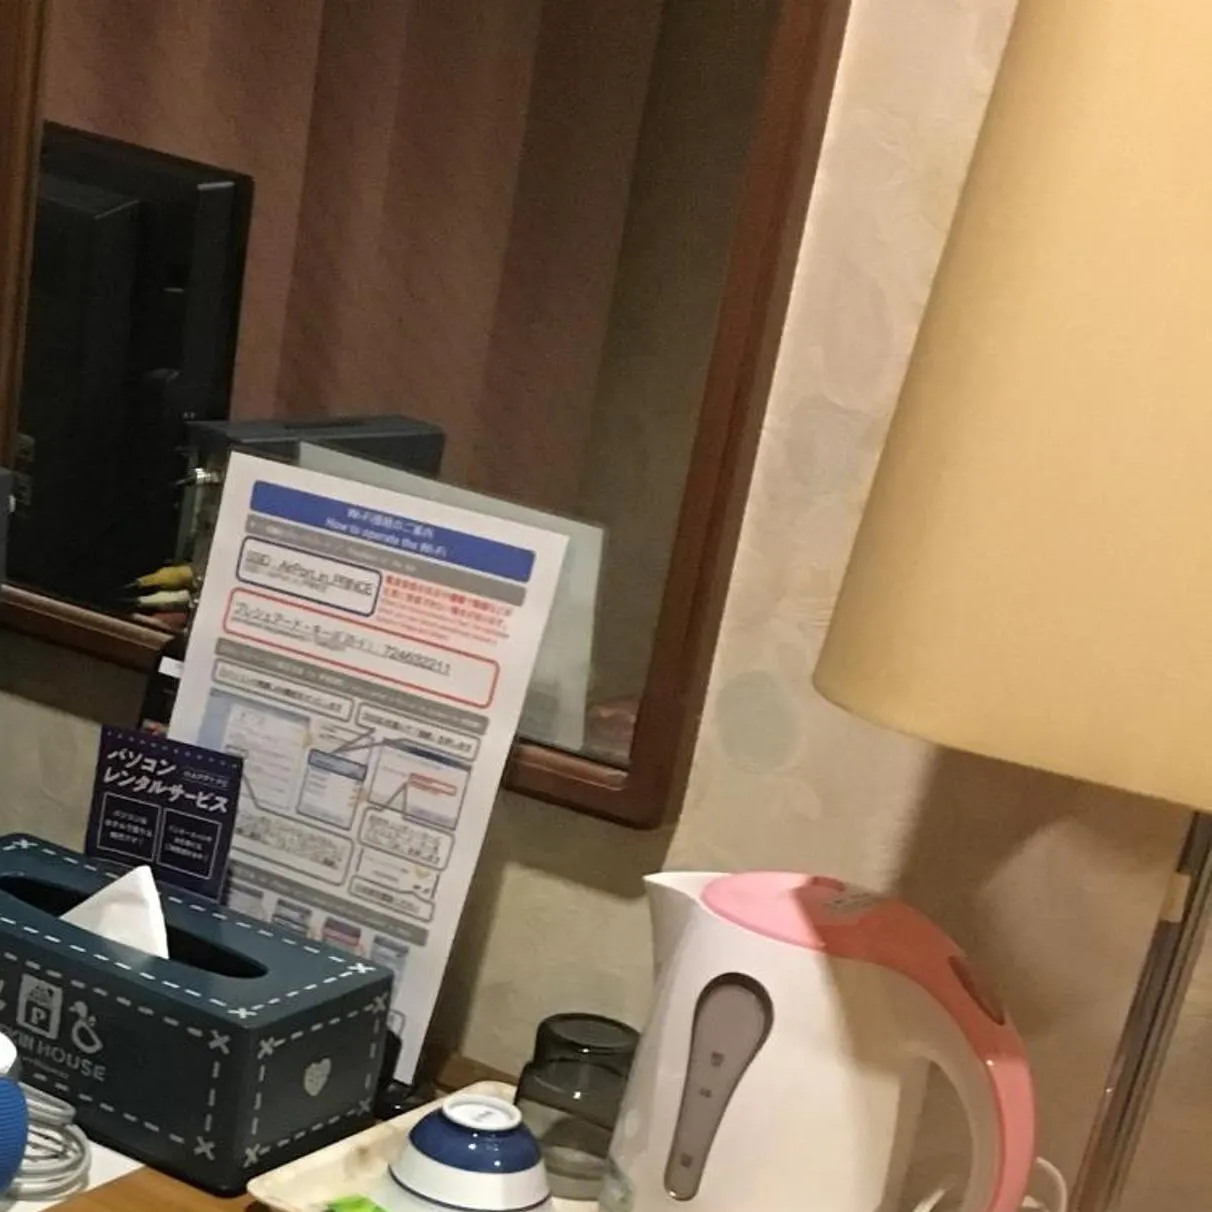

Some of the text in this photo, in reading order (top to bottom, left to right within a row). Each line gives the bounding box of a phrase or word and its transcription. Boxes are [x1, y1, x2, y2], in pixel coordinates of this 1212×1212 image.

[107, 748, 177, 776] パソコン
[103, 767, 229, 813] レンタルサービス
[37, 1039, 107, 1082] HOUSE
